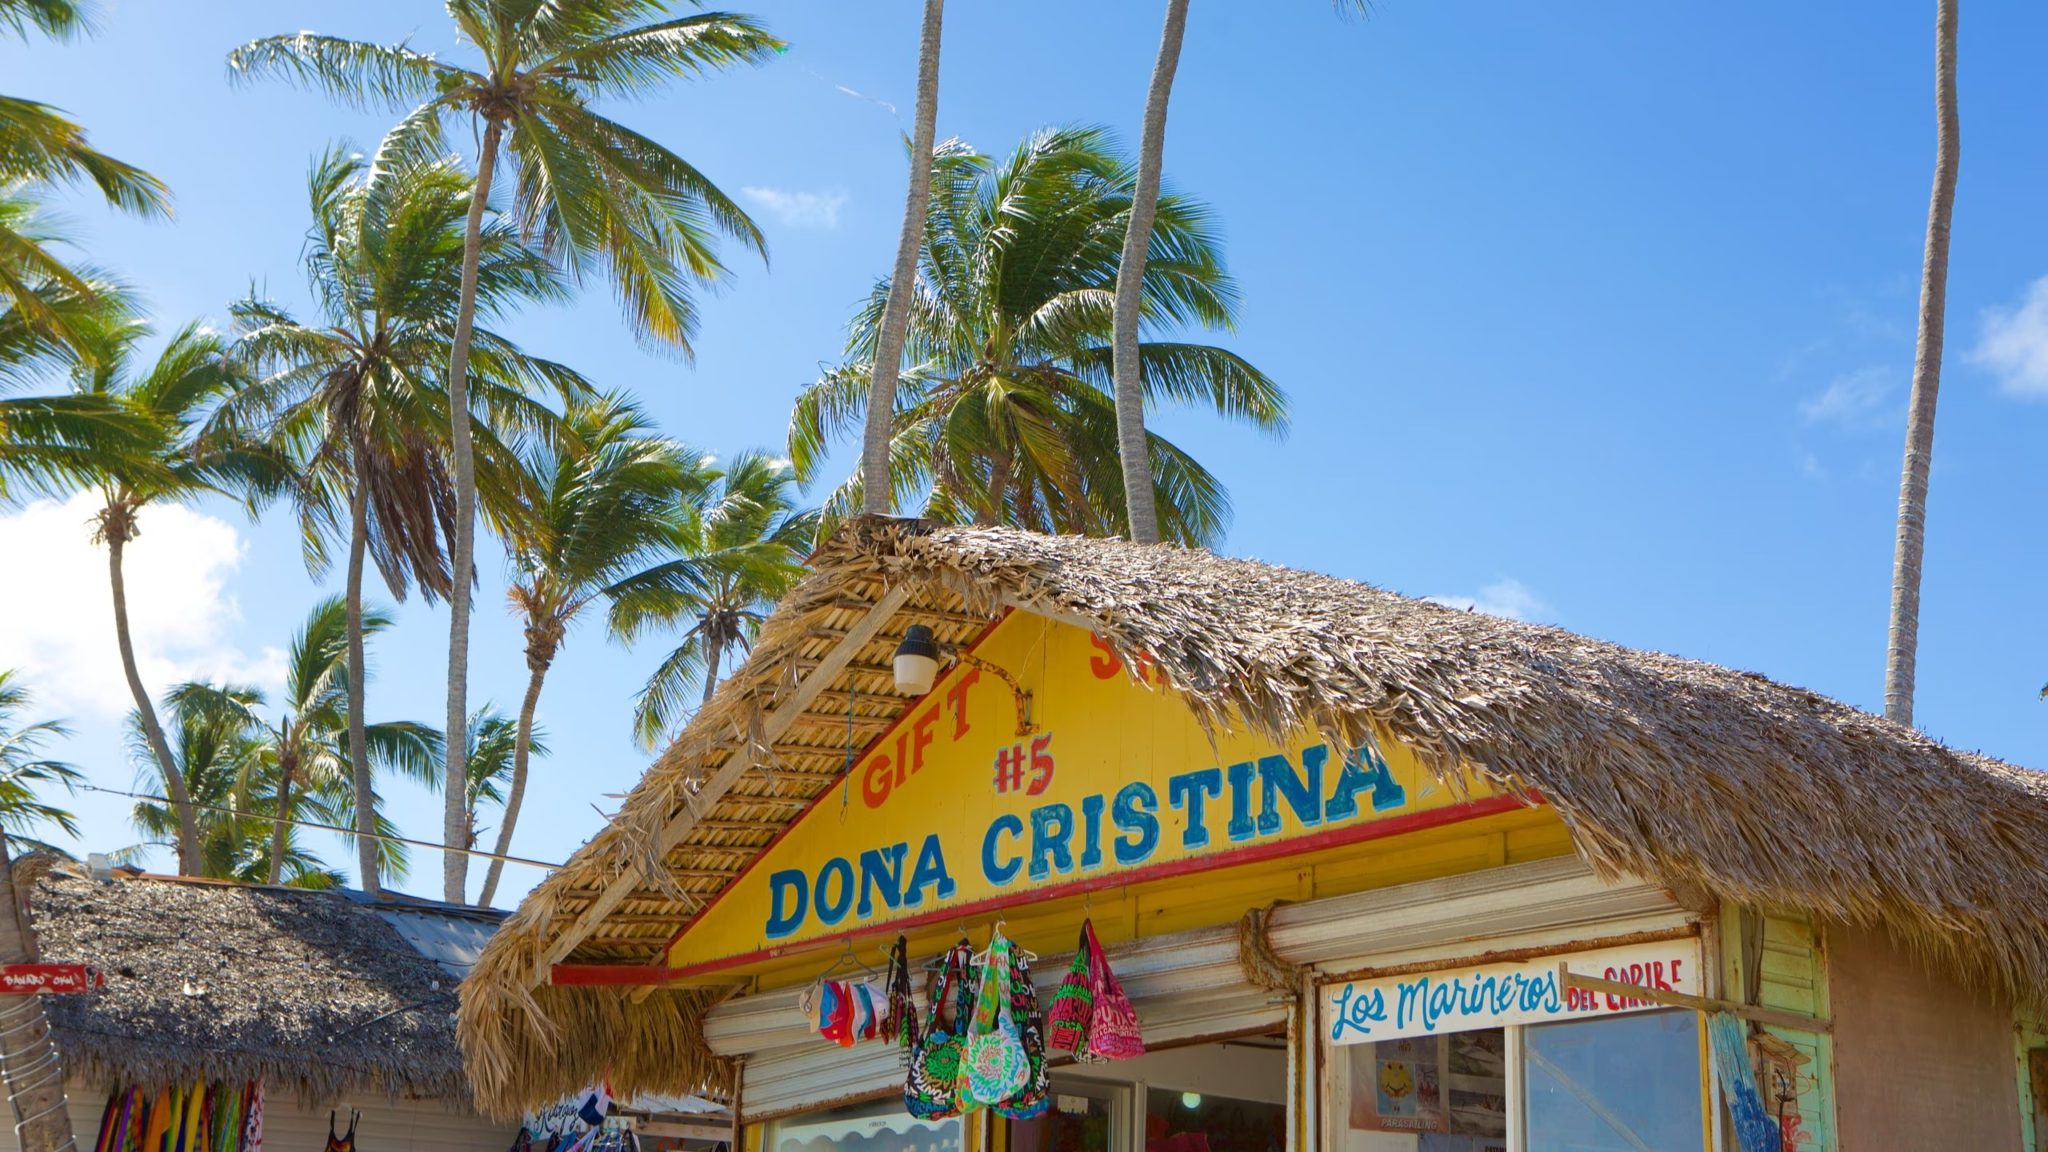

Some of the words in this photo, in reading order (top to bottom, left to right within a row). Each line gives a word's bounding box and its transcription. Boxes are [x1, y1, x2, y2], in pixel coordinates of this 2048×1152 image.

[862, 668, 981, 809] GIFT
[993, 732, 1055, 797] #5
[981, 742, 1406, 887] CRISTINA
[1331, 983, 1388, 1041] Los
[1397, 970, 1562, 1031] Marineros
[1567, 985, 1599, 1012] DEL
[1381, 1119, 1438, 1130] PARASAILING
